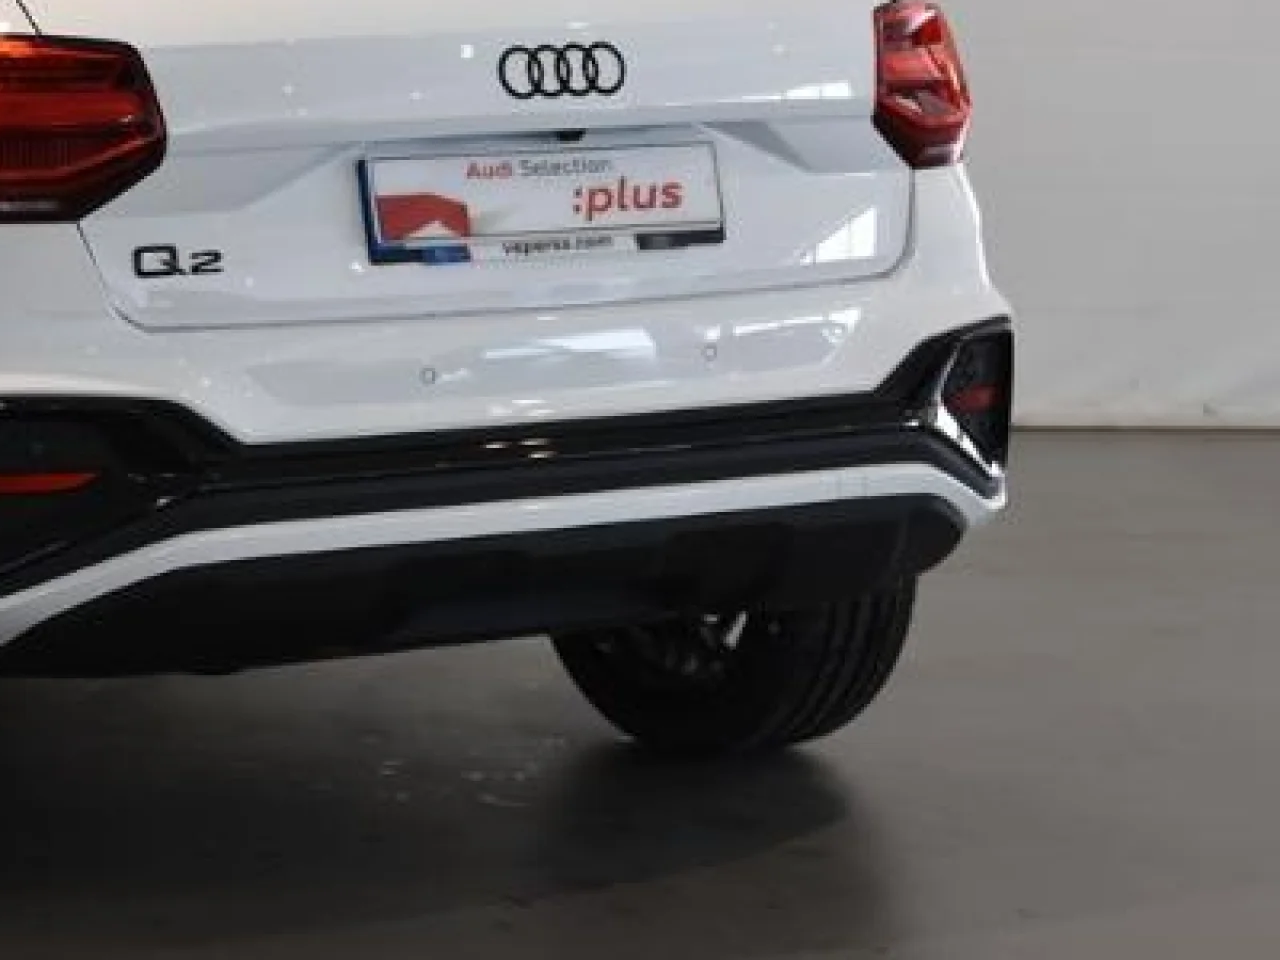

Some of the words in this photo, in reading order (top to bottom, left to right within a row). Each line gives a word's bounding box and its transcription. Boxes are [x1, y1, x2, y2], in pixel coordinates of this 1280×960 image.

[466, 161, 513, 179] Audi
[519, 159, 611, 176] Selection
[572, 176, 682, 221] :plus
[131, 244, 224, 278] Q2
